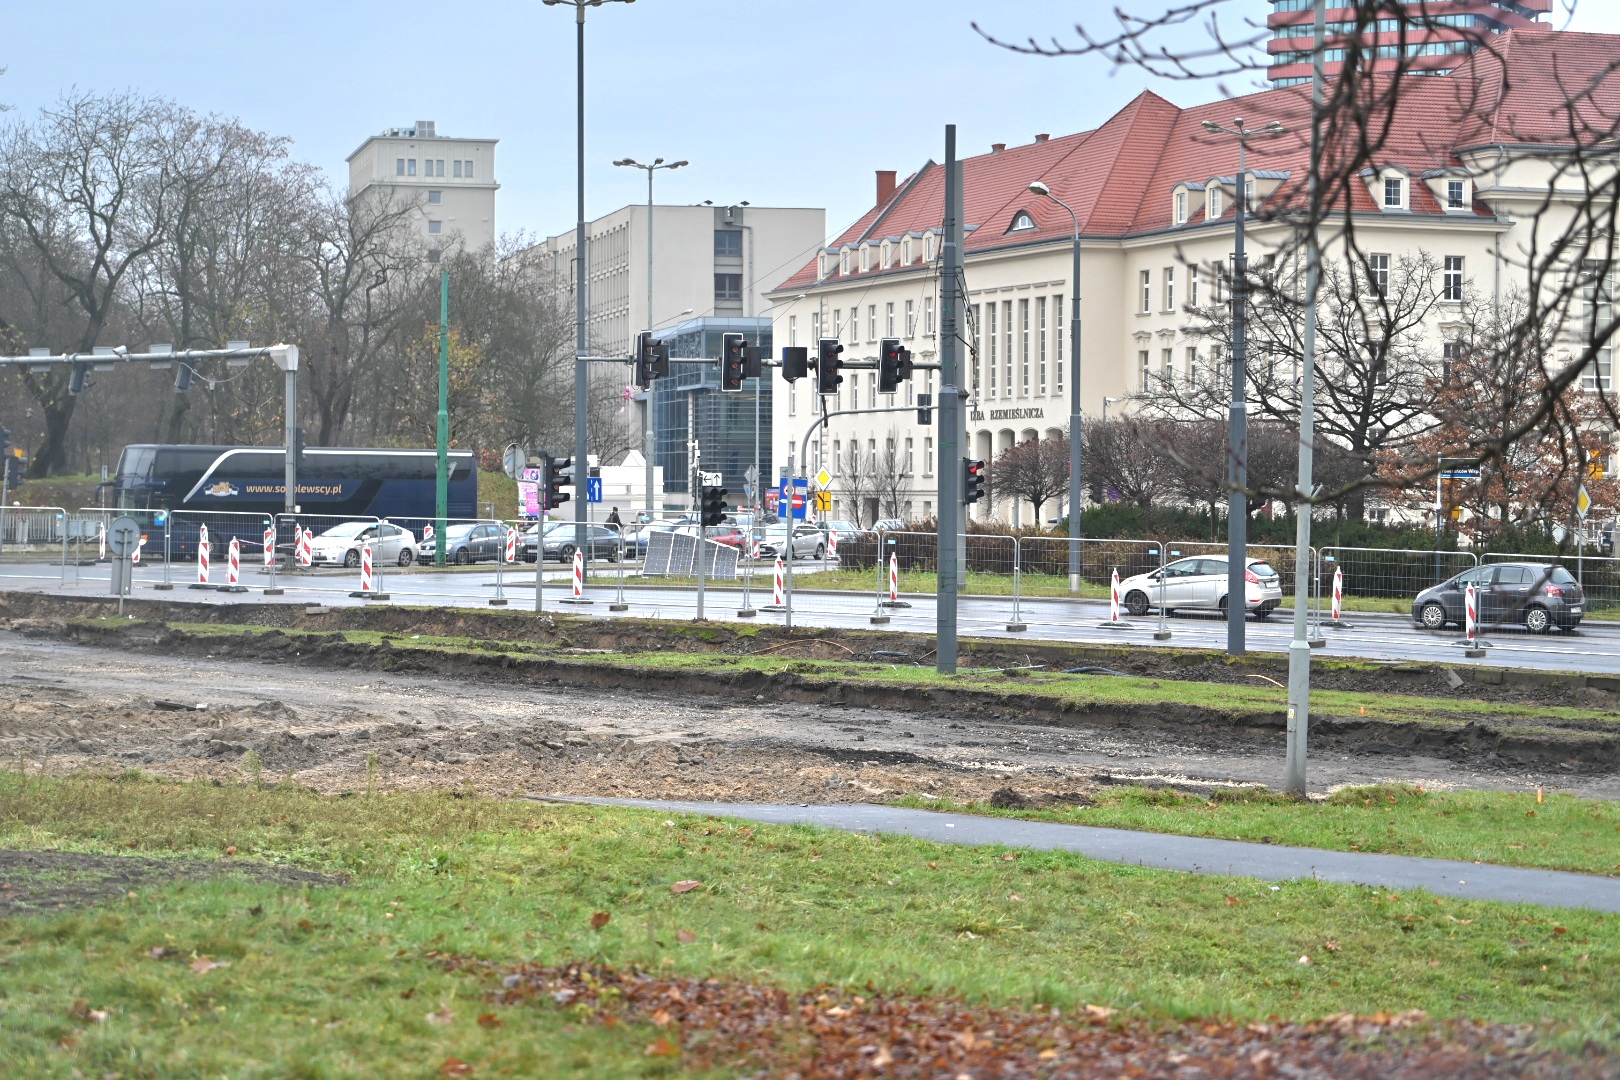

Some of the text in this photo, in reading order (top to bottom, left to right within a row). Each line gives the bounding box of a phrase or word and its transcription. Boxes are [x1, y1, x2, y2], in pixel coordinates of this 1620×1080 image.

[970, 408, 1044, 421] IZBA RZEMIEŚLNICZA
[246, 483, 342, 495] www.solewscy.pl
